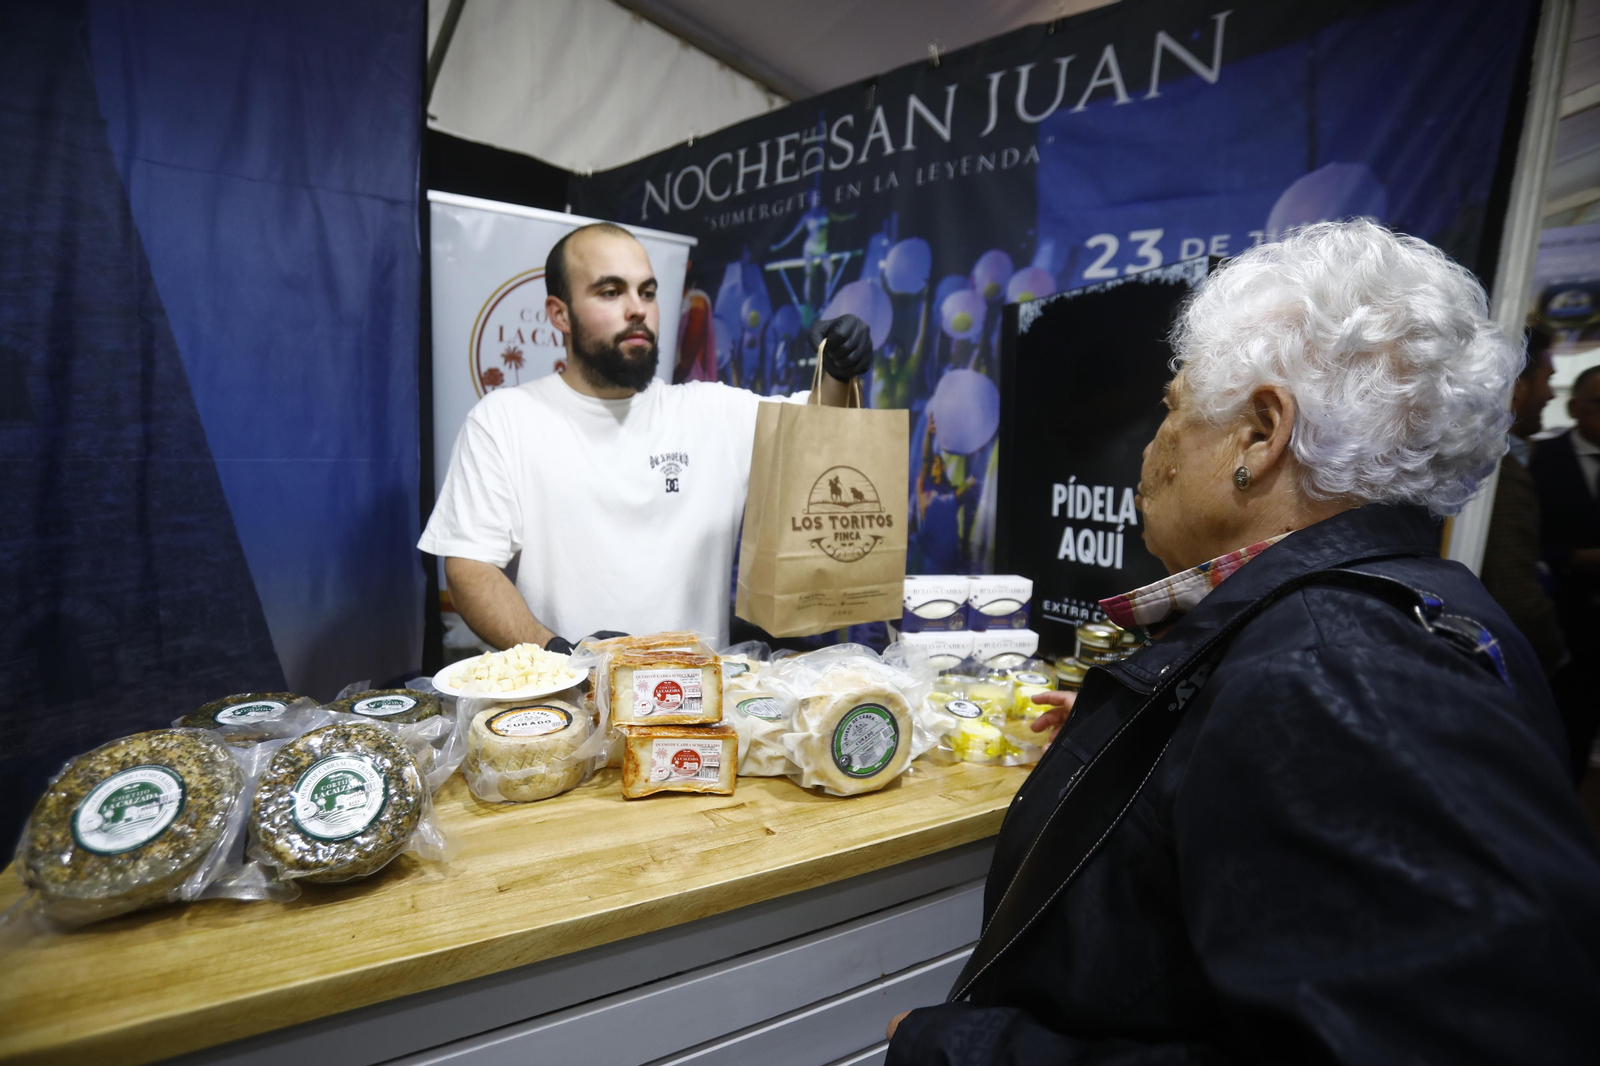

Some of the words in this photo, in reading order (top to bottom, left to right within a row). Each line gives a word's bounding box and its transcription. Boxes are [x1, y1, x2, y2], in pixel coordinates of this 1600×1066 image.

[640, 131, 801, 220] NOCHE
[828, 84, 955, 171] SAN
[981, 10, 1234, 138] JUAN
[834, 181, 862, 204] EN
[873, 171, 900, 194] LA
[1082, 228, 1164, 280] 23
[1179, 234, 1231, 261] DE
[1051, 475, 1138, 525] PÍDELA
[791, 515, 823, 531] LOS
[828, 514, 893, 531] TORITOS
[833, 531, 862, 541] FINCA
[1057, 523, 1126, 570] AQUÍ
[1042, 599, 1090, 620] EXTRA
[506, 719, 552, 728] CURADO
[103, 803, 115, 811] LA
[116, 793, 159, 808] CALZADA
[112, 789, 150, 802] CORTIJO
